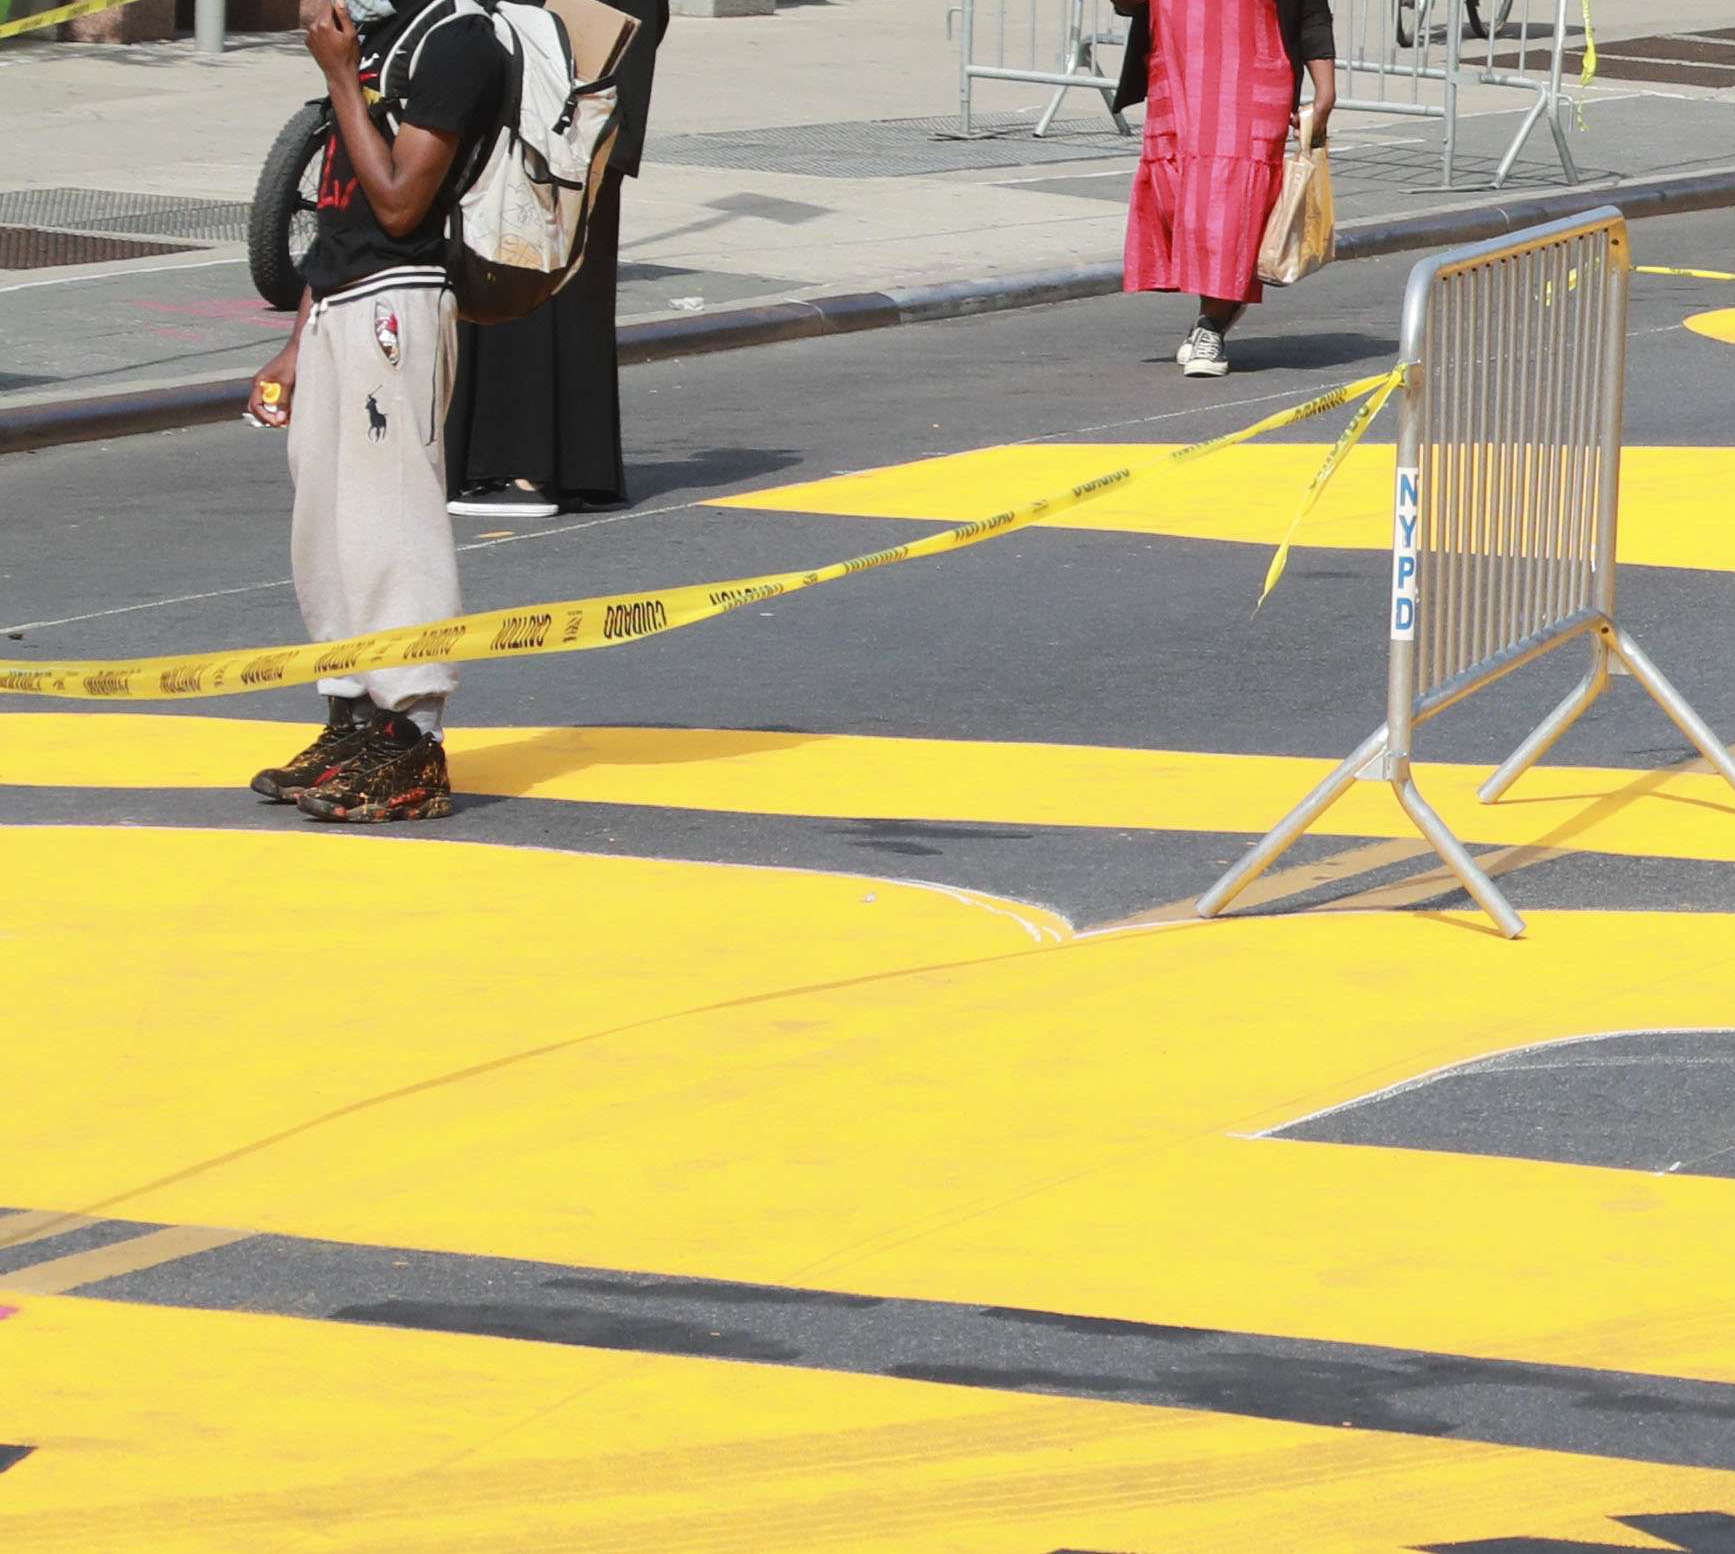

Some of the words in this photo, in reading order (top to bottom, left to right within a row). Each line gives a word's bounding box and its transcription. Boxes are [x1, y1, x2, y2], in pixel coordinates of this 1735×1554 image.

[1395, 472, 1419, 631] NYPD
[490, 614, 552, 651] CAUTION
[602, 599, 668, 639] CUIDADO
